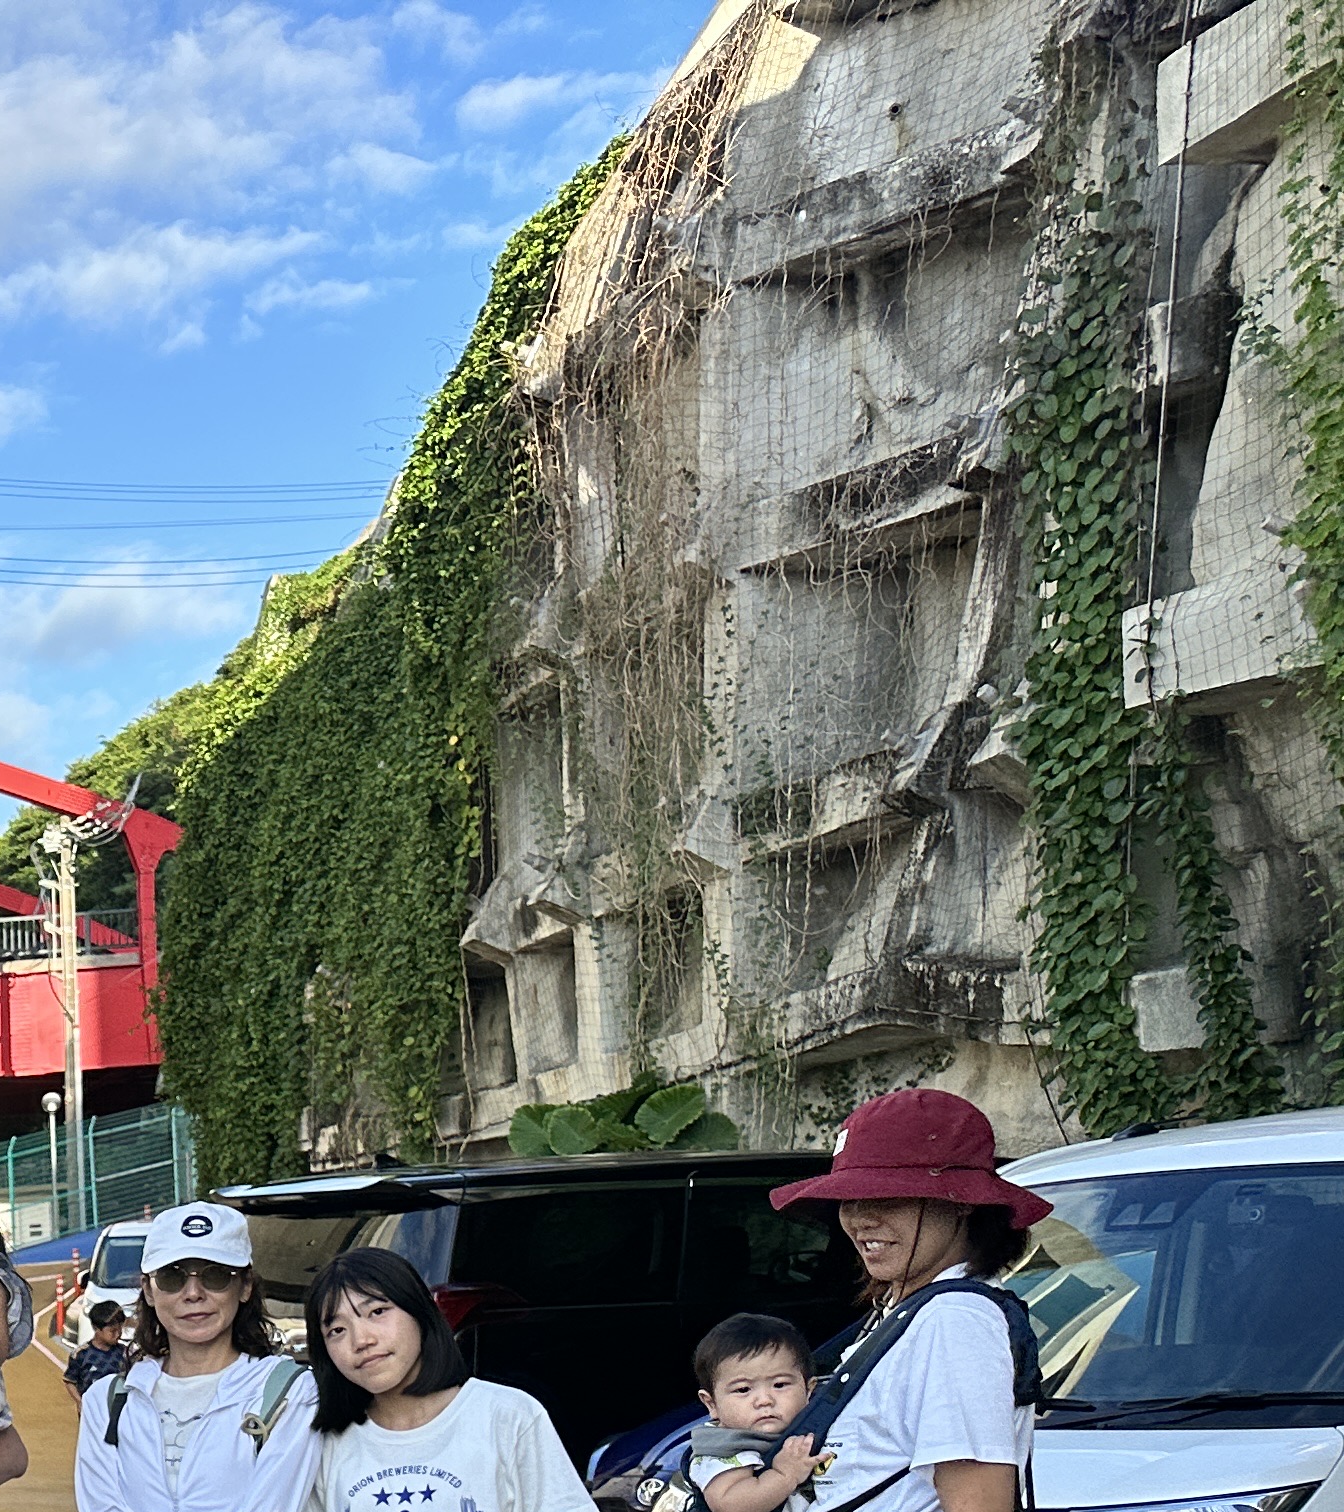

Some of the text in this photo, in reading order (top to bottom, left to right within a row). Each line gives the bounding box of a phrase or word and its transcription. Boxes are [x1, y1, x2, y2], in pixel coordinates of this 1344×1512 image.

[348, 1465, 463, 1498] ORION BREWERIES LIMITED
